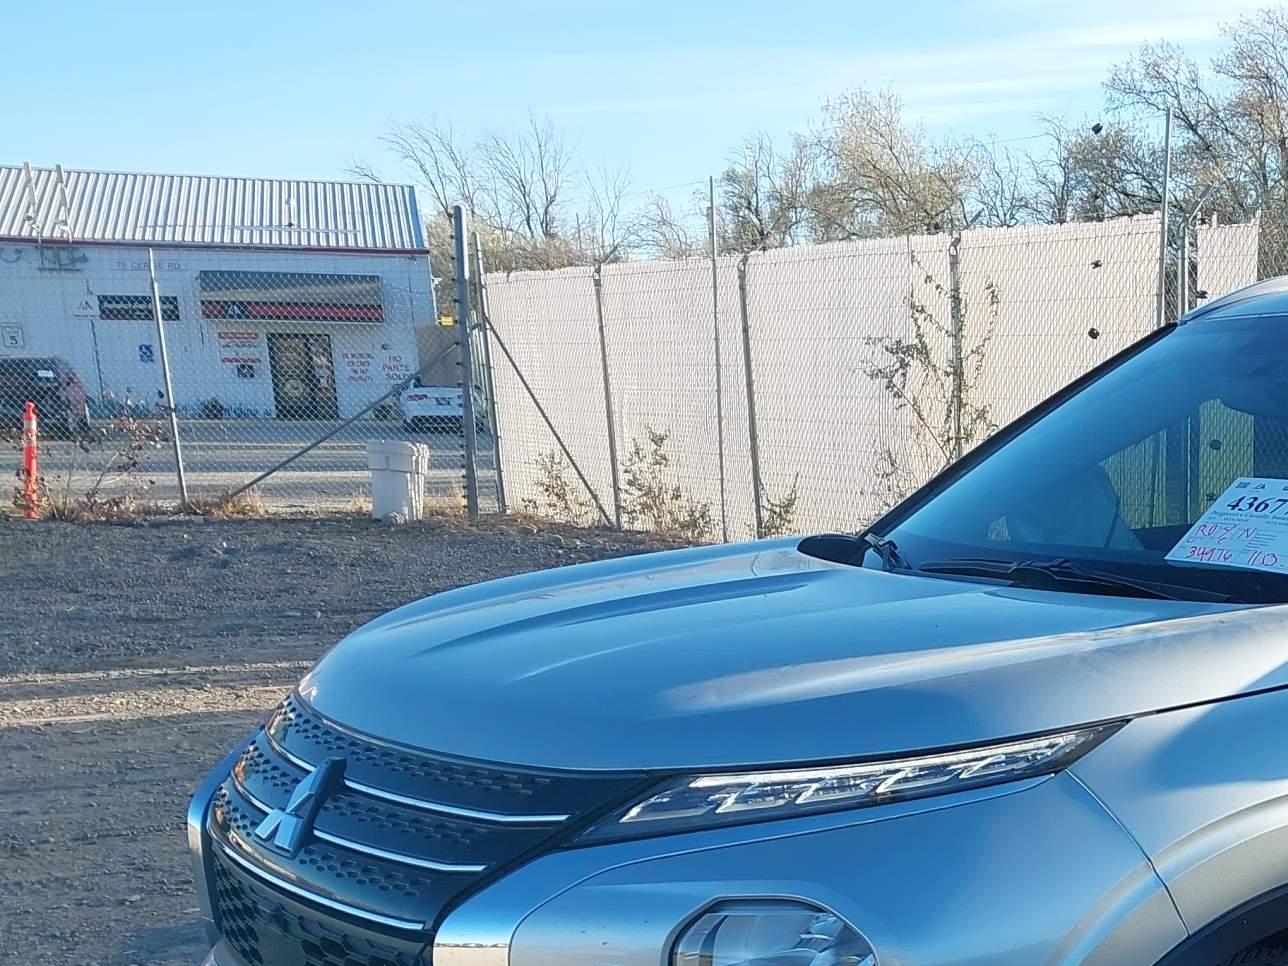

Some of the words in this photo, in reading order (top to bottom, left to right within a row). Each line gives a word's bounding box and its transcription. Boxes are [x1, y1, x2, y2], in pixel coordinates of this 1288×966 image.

[8, 334, 18, 346] 5
[388, 355, 402, 363] NO
[382, 364, 410, 373] PARTS
[385, 372, 410, 380] SOLD
